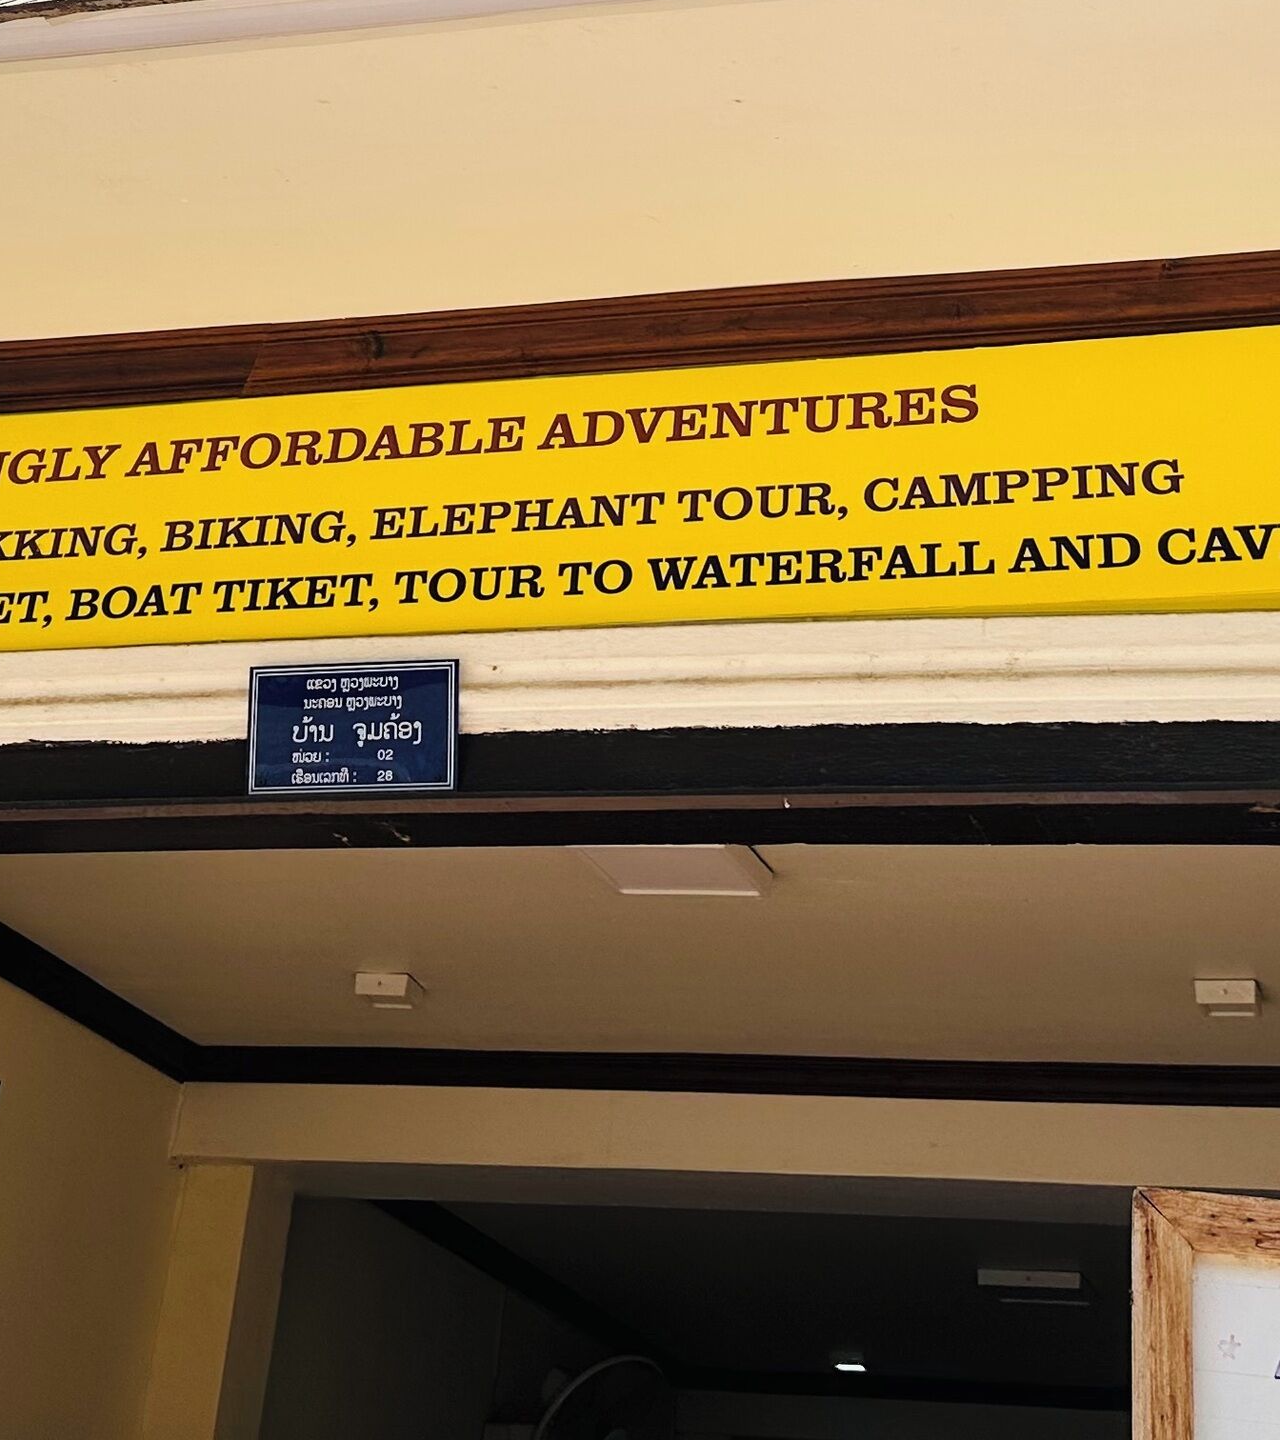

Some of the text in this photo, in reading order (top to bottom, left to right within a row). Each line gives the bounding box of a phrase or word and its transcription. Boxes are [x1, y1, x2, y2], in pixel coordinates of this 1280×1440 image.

[125, 416, 525, 477] AFFORDABLE
[537, 385, 978, 449] ADVENTURES
[160, 511, 356, 552] BIKING,
[370, 492, 665, 540] ELEPHANT
[678, 483, 848, 522] TOUR,
[864, 459, 1184, 512] CAMPPING
[65, 582, 202, 620] BOAT
[213, 573, 378, 612] TIKET,
[395, 565, 545, 604] TOUR
[558, 560, 632, 595] TO
[647, 541, 995, 591] WATERFALL
[1008, 533, 1140, 573] AND
[376, 769, 393, 782] 28
[377, 748, 394, 761] 02
